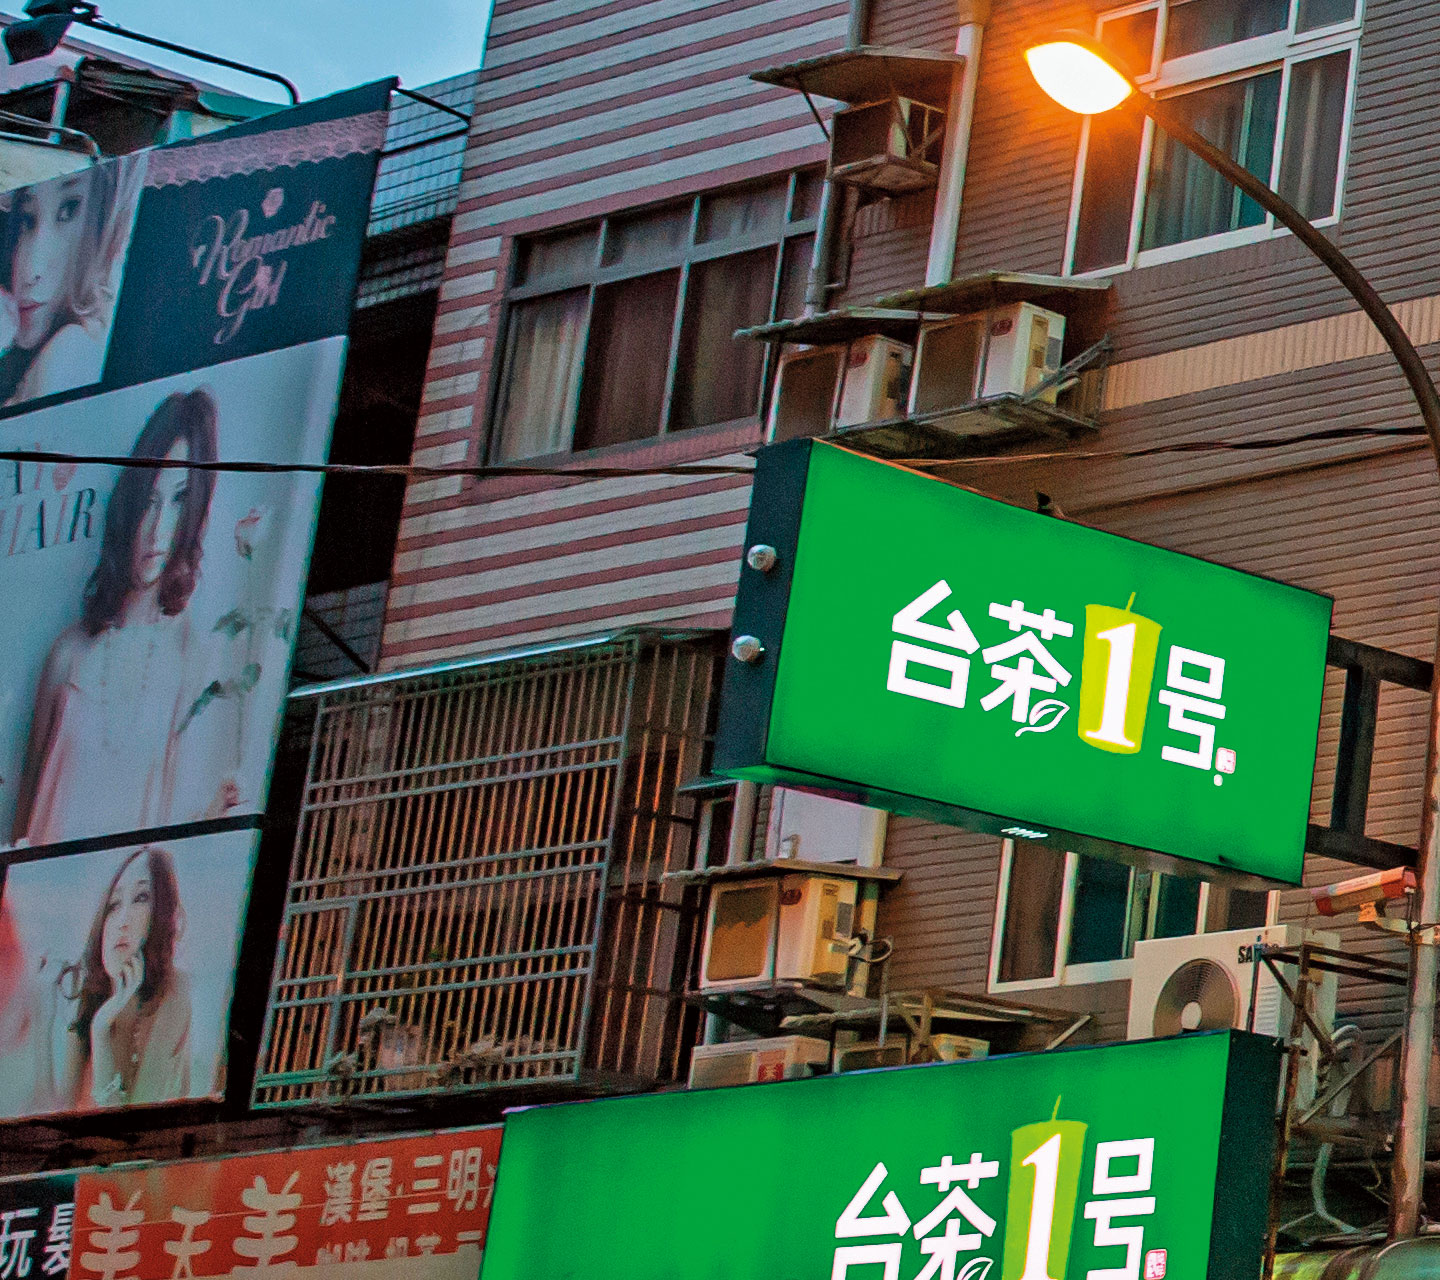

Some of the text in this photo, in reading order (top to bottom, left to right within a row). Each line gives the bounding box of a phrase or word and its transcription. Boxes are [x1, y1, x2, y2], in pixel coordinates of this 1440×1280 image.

[192, 200, 336, 285] Romantic
[886, 578, 1228, 773] 台茶1号
